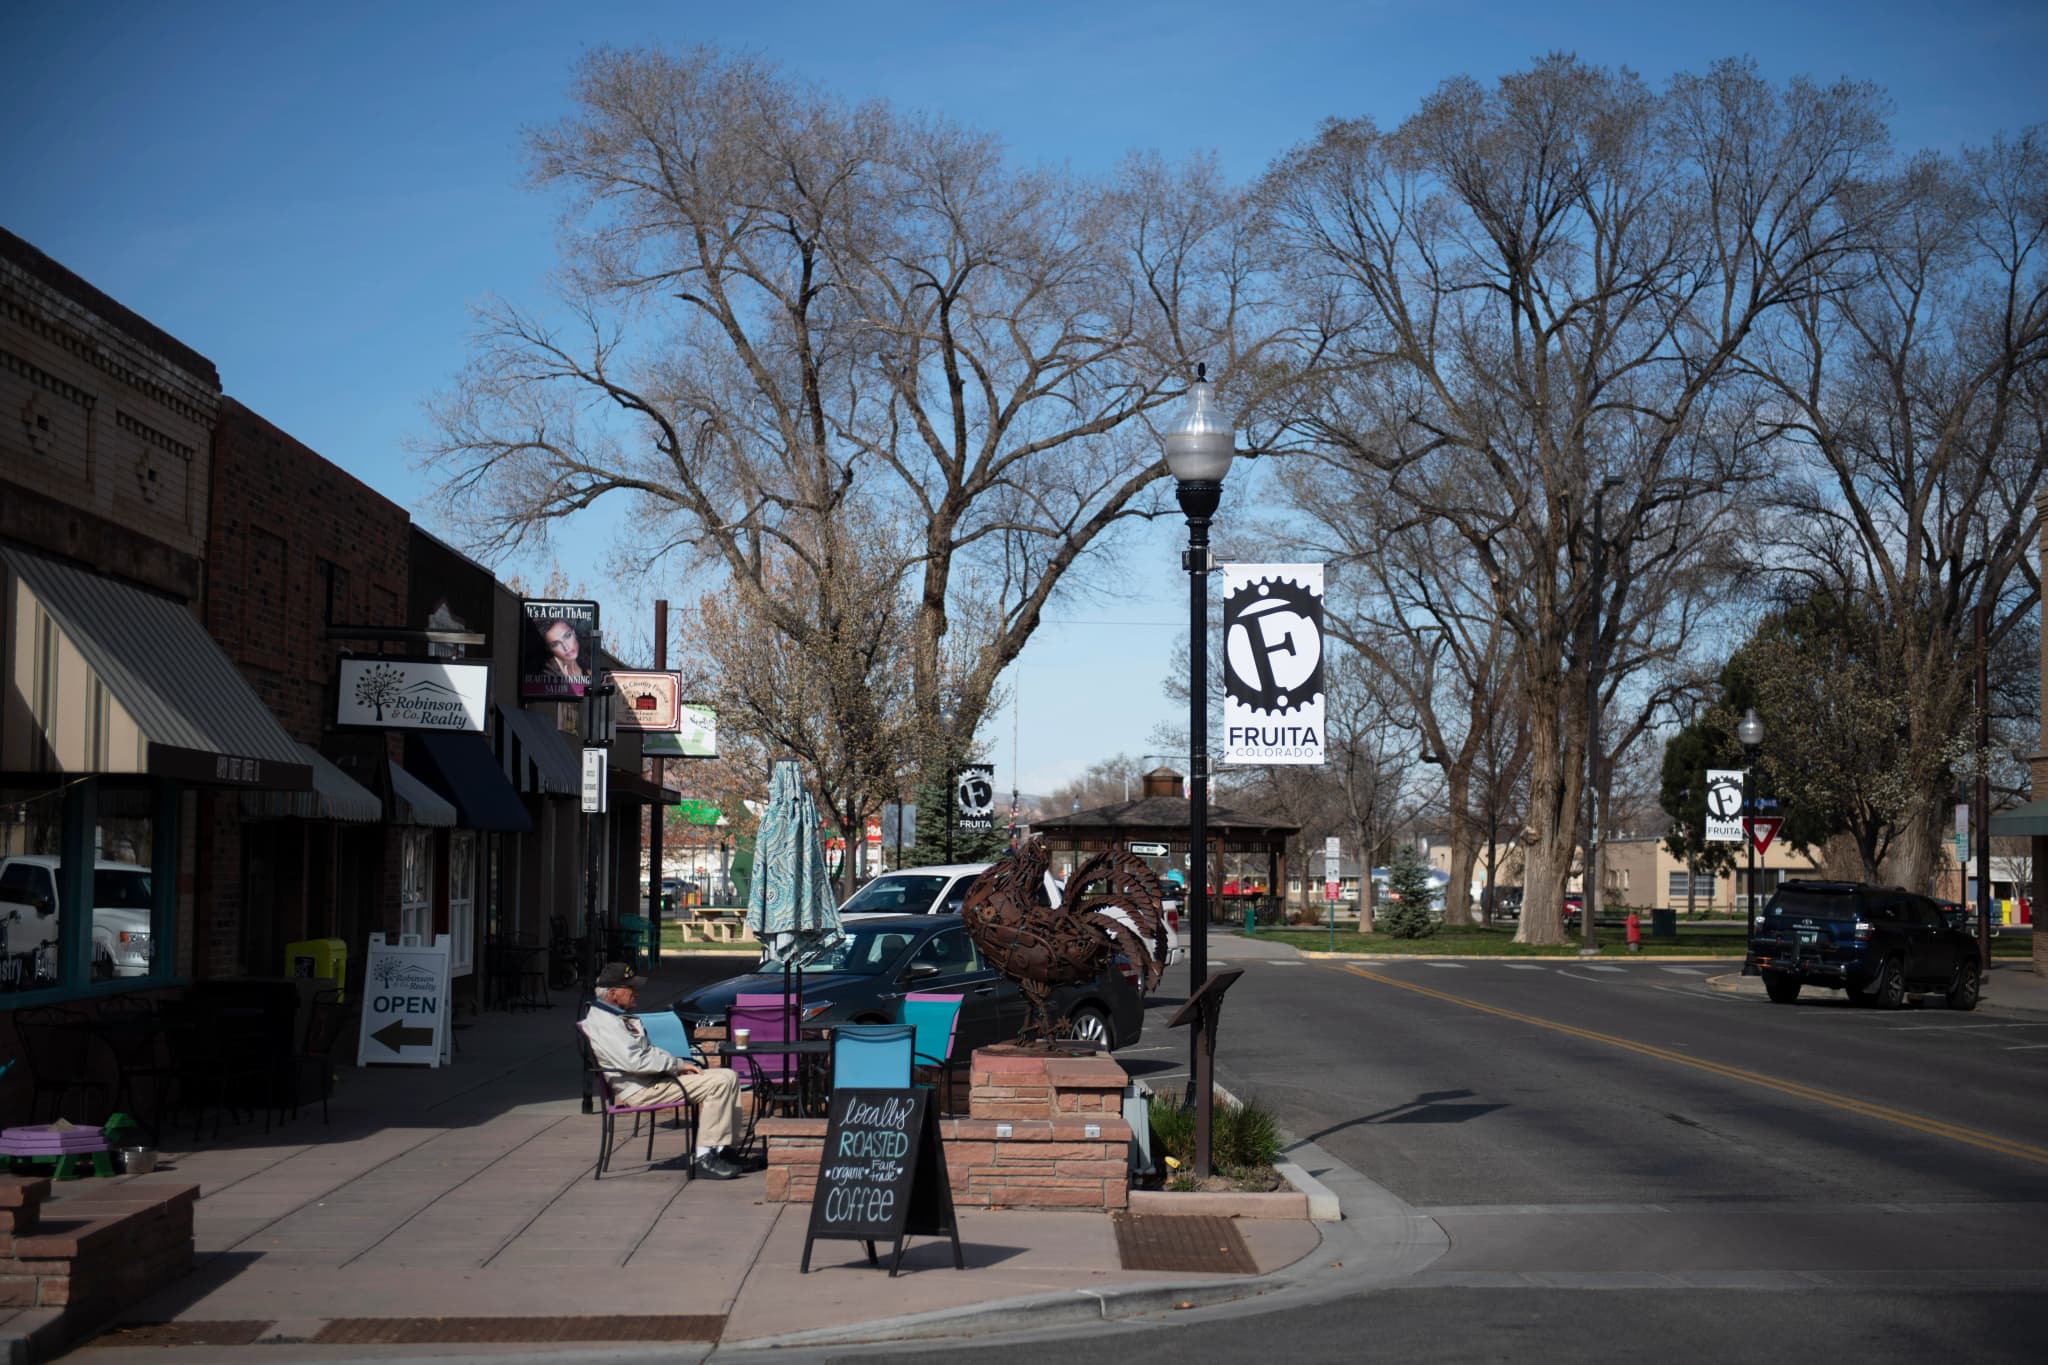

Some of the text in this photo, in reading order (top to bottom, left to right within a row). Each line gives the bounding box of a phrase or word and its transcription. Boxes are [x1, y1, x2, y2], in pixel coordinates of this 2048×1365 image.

[540, 607, 547, 618] A
[548, 607, 564, 618] Girl
[566, 607, 592, 622] ThAng
[396, 696, 463, 712] Robinson
[391, 709, 468, 729] & Co. Realty
[1229, 726, 1319, 747] FRUITA
[1234, 746, 1315, 758] COLORADO
[959, 820, 992, 829] FRUITA
[1708, 826, 1741, 836] FRUITA
[409, 982, 437, 993] Realty
[373, 995, 436, 1014] OPEN
[839, 1096, 915, 1130] locally
[838, 1130, 909, 1159] ROASTED
[869, 1170, 898, 1183] trade
